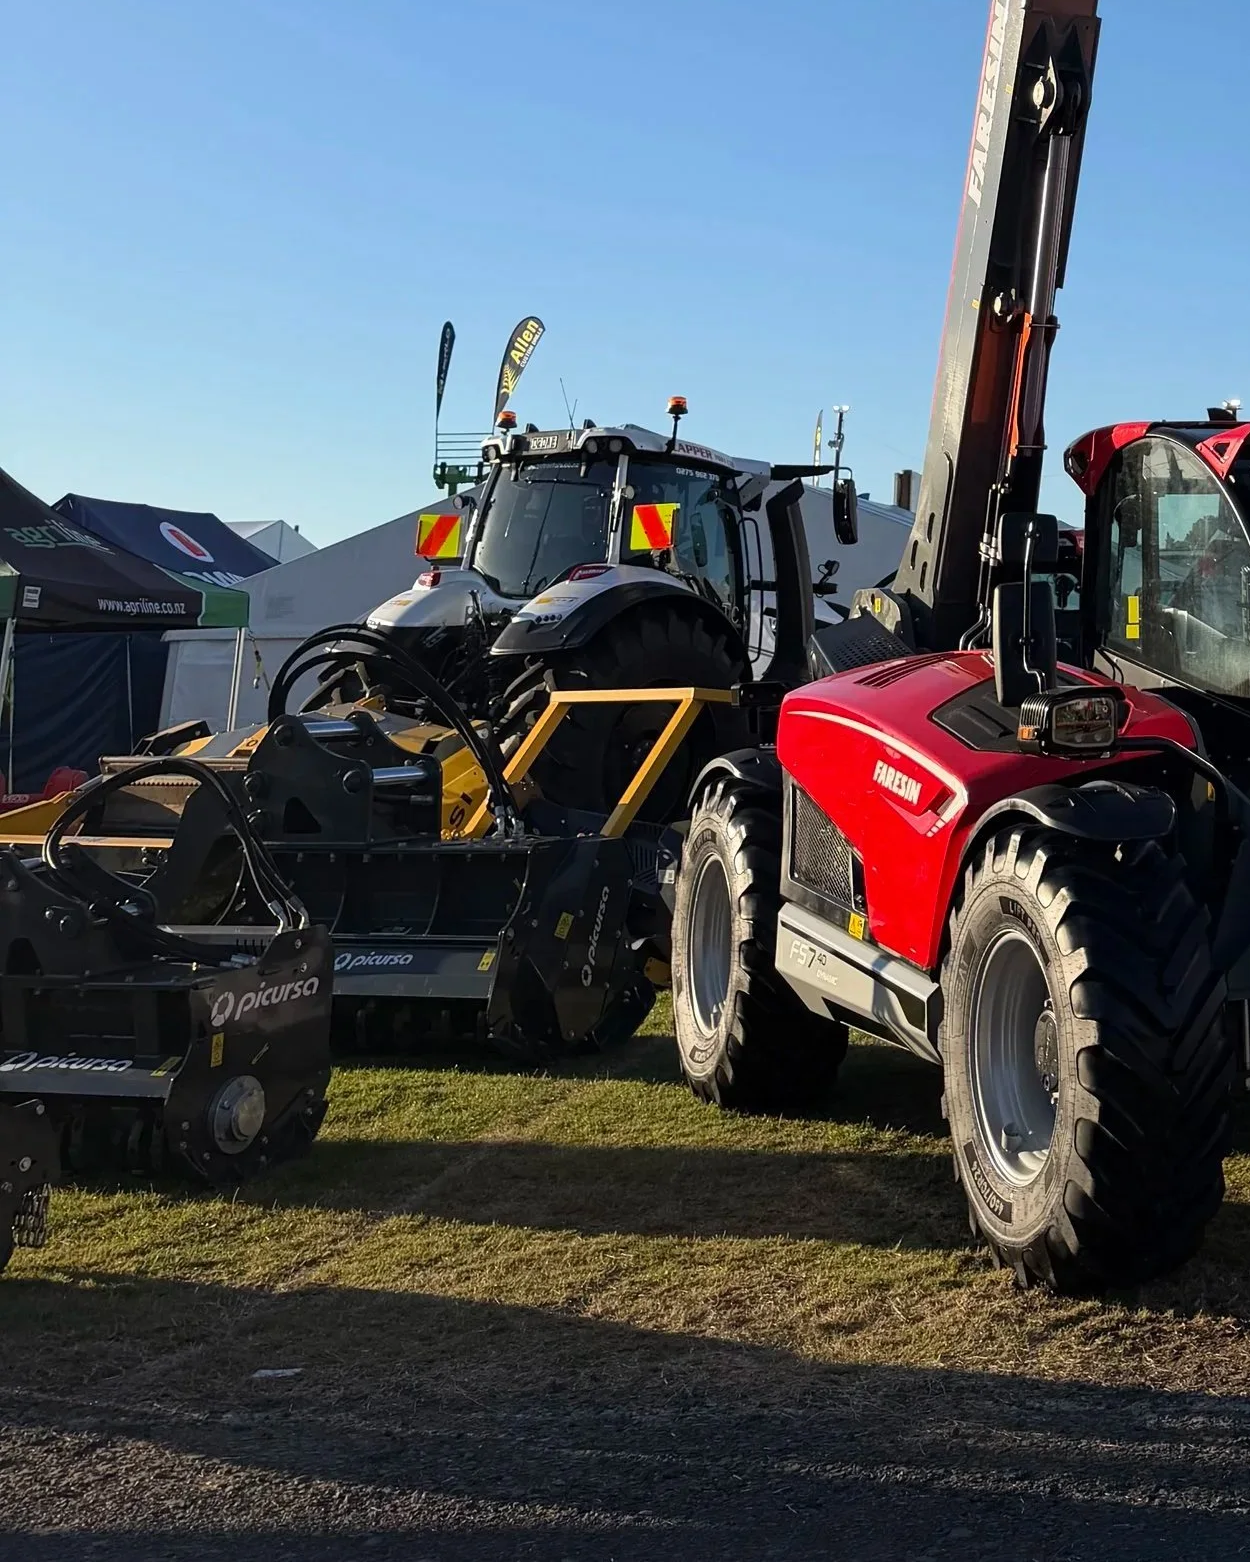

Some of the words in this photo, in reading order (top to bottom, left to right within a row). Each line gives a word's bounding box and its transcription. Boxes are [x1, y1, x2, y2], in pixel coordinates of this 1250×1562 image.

[968, 0, 1005, 208] FARESIN
[510, 320, 539, 365] Allen
[98, 597, 187, 615] www.agriline.co.nz
[872, 758, 924, 806] FARESIN
[233, 976, 320, 1022] picursa
